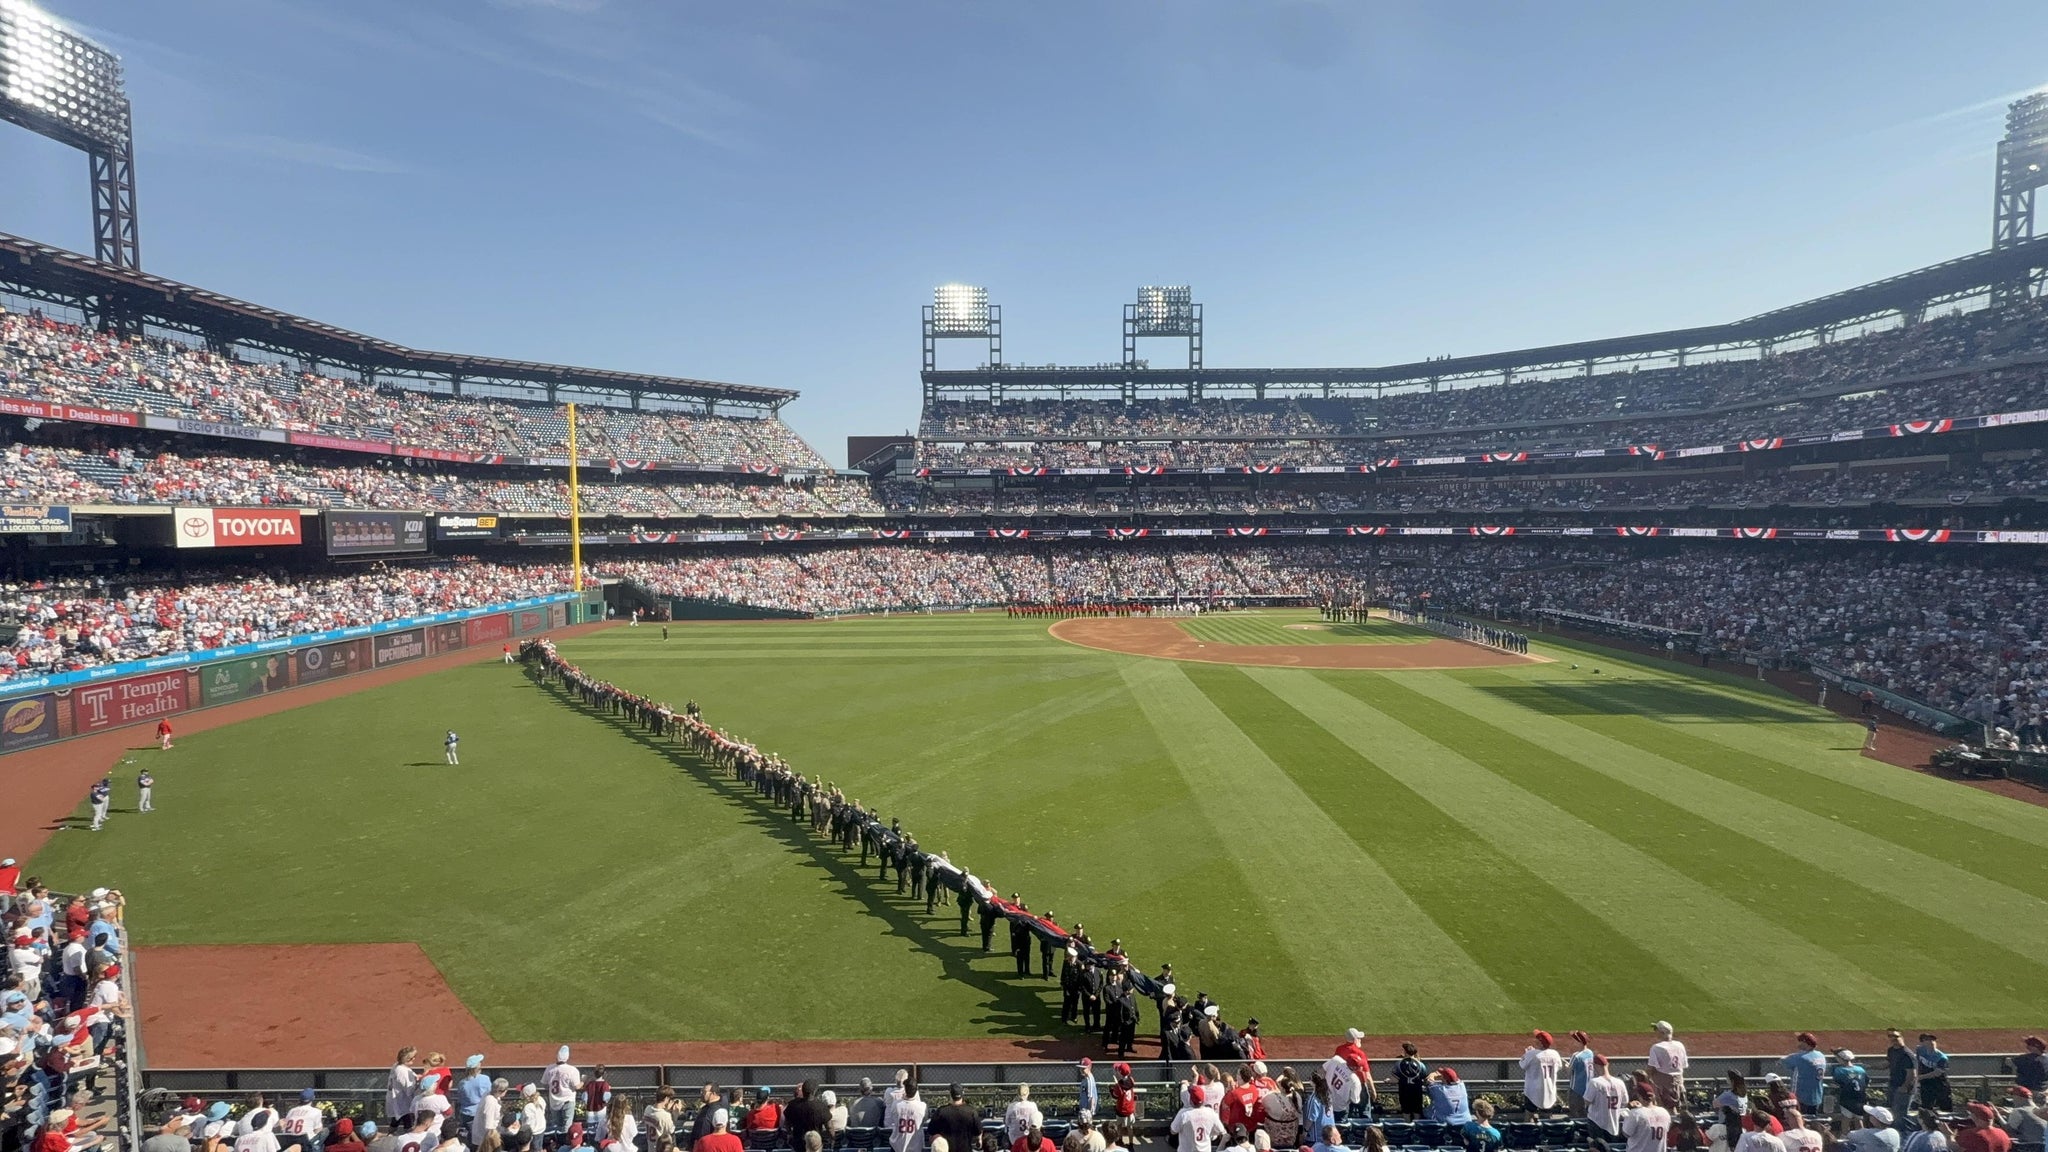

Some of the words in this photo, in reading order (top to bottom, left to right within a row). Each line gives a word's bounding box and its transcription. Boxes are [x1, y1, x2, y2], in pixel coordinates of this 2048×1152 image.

[22, 404, 43, 415] win
[69, 409, 100, 421] Deals
[101, 412, 118, 423] roll
[119, 415, 130, 425] in
[2000, 411, 2039, 425] OPENING
[177, 420, 221, 434] LISCIO'S
[224, 426, 261, 438] BAKERY
[218, 518, 295, 536] TOYOTA
[439, 516, 477, 529] theScore
[478, 518, 495, 526] BET
[1999, 531, 2039, 543] OPENING
[379, 645, 409, 663] OPENING
[409, 642, 422, 657] DAY
[119, 675, 181, 700] Temple
[121, 695, 178, 720] Health
[1671, 1055, 1680, 1069] 3
[551, 1080, 560, 1095] 3
[1852, 1079, 1861, 1091] 3
[1451, 1100, 1460, 1113] 7
[1606, 1096, 1618, 1110] 12
[285, 1119, 304, 1134] 26
[899, 1118, 916, 1134] 28
[1650, 1126, 1664, 1141] 10
[1195, 1127, 1205, 1142] 3
